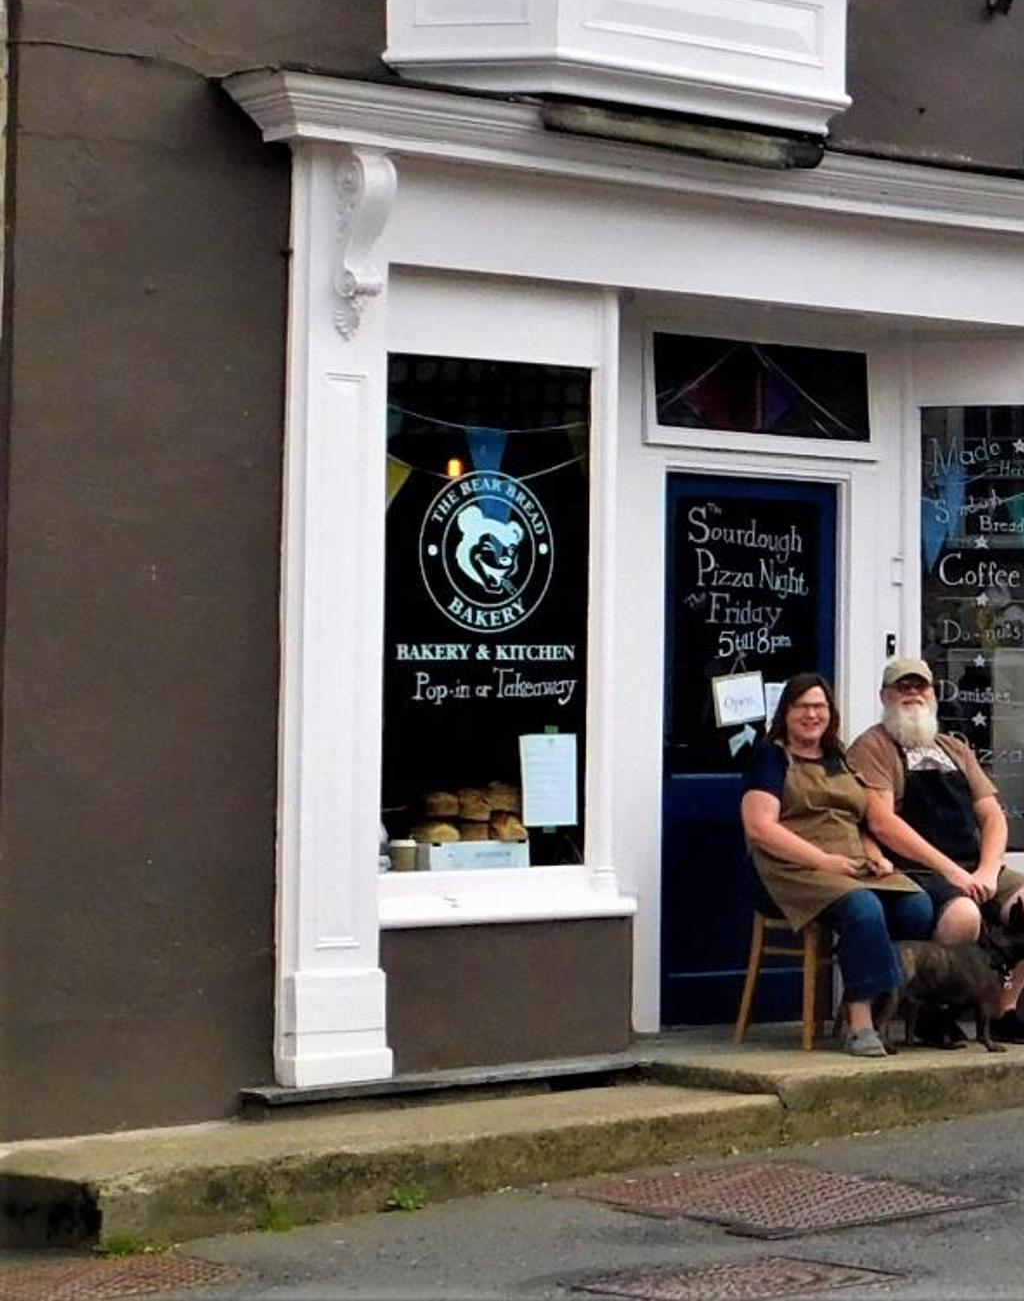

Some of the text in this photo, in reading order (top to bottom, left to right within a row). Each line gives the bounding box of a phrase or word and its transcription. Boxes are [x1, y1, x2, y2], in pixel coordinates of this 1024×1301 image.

[930, 438, 1000, 477] Made
[431, 478, 545, 535] THE BEAR BREAD
[980, 515, 1024, 533] Bread
[688, 506, 802, 563] Sourdough
[695, 548, 808, 599] Pizza Night
[939, 552, 1020, 587] Coffee
[448, 596, 526, 627] BAKERY
[705, 591, 782, 629] Friday
[396, 644, 575, 660] BAKERY & KITCHEN
[411, 667, 578, 705] Pop-in or Takeaway
